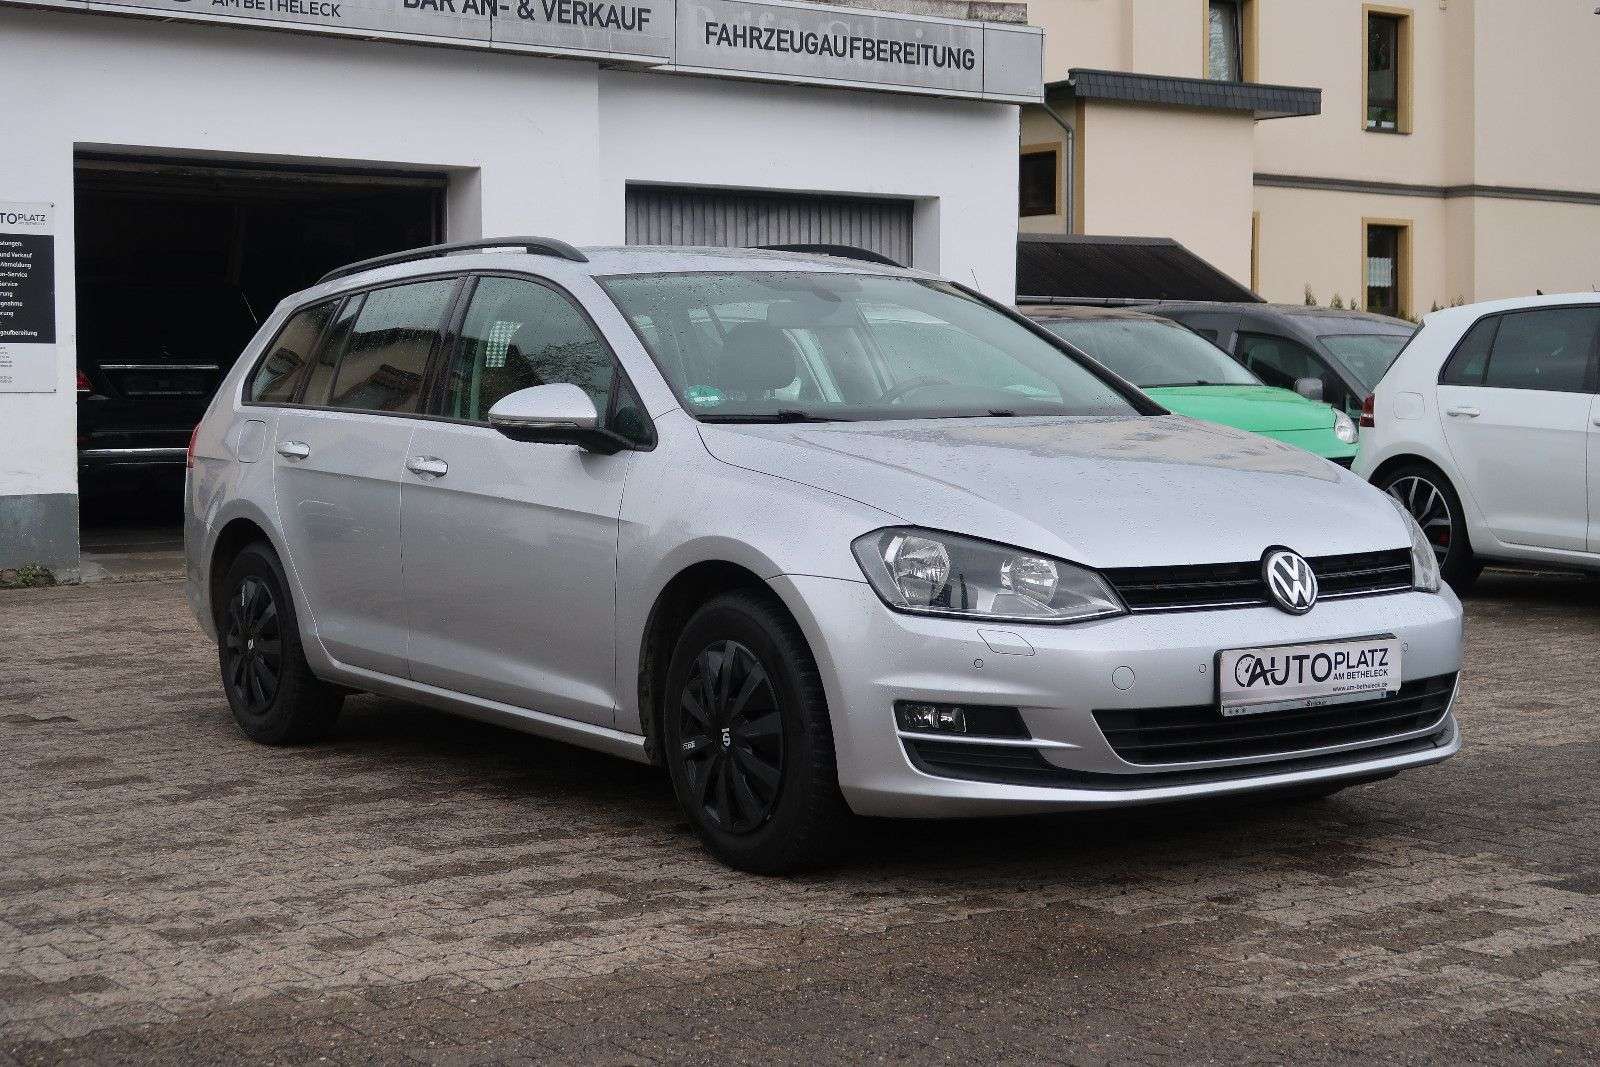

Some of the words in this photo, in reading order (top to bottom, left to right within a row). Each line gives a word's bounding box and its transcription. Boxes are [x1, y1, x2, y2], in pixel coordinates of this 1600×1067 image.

[244, 0, 341, 17] BETHELECK
[462, 0, 509, 16] AN-
[516, 0, 535, 21] &
[541, 0, 651, 31] VERKAUF
[705, 21, 975, 71] FAHRZEUGAUFBEREITUNG
[1333, 672, 1345, 681] AM
[1346, 668, 1389, 680] BETHELECK
